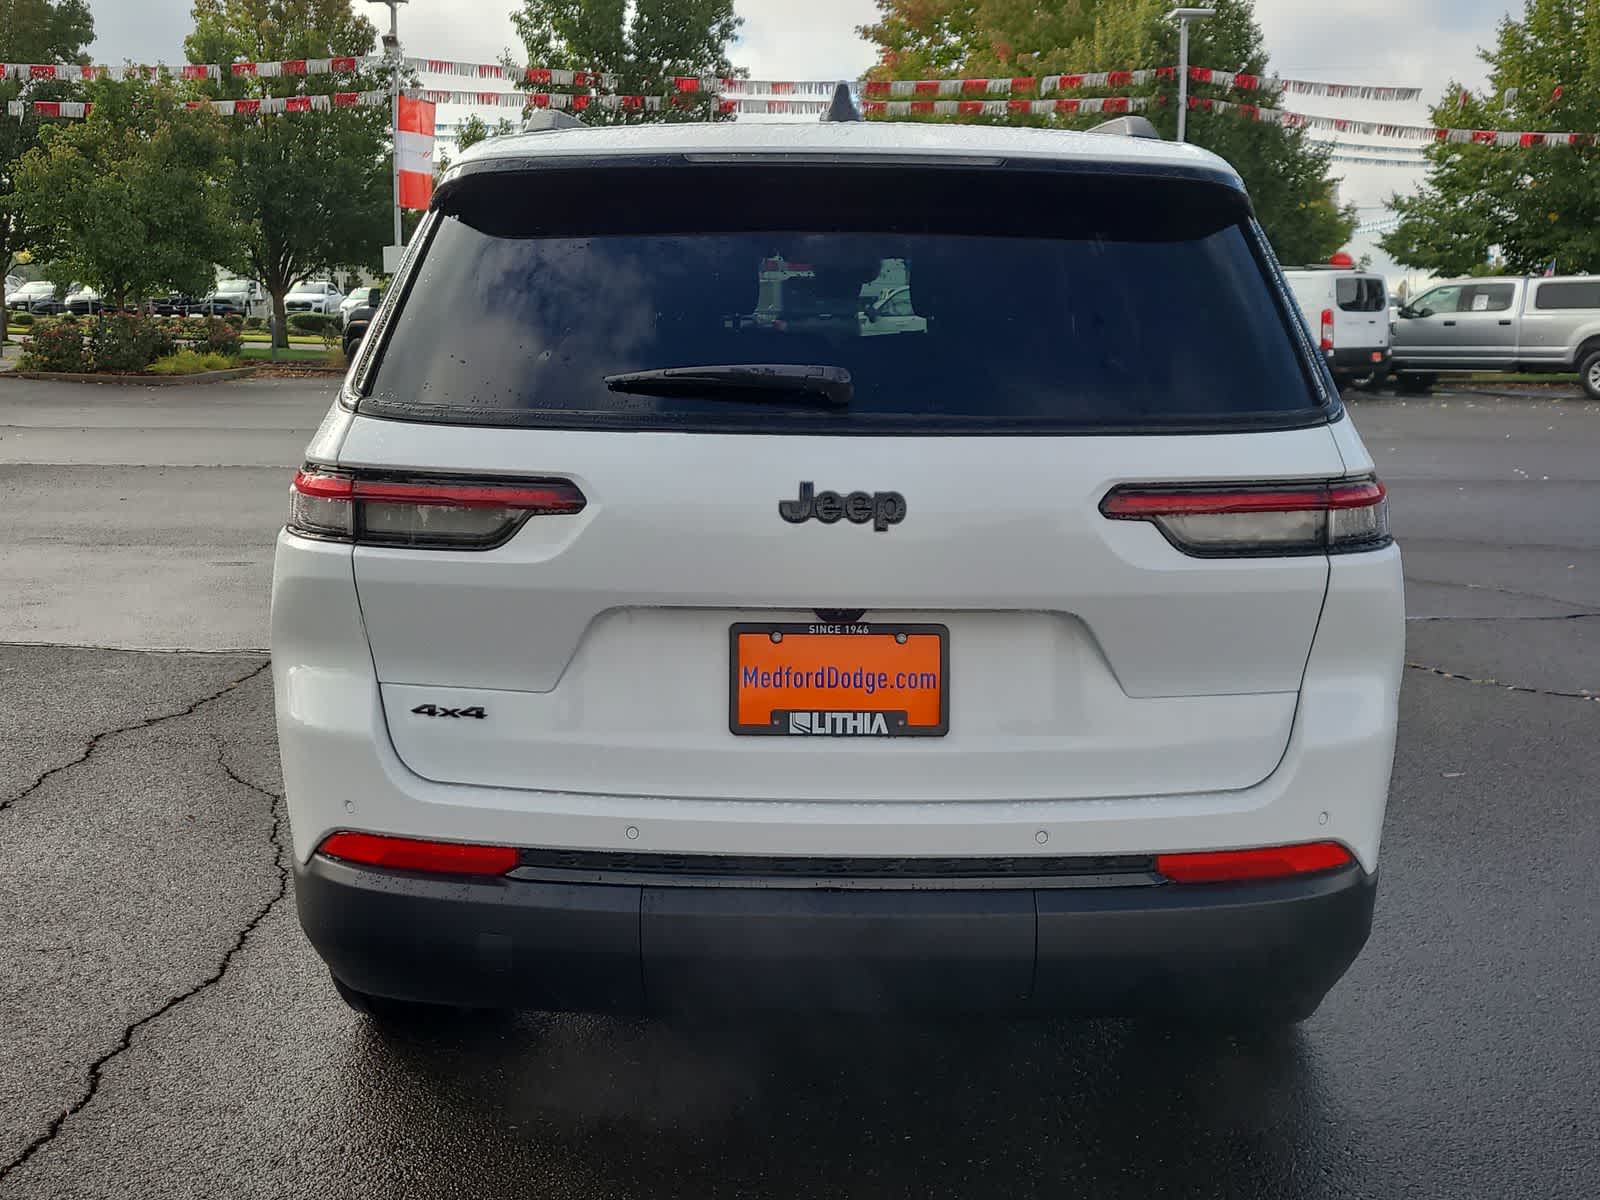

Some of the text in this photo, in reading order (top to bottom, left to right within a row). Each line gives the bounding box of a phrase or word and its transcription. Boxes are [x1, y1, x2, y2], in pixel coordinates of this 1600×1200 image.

[779, 481, 906, 532] Jeep
[809, 624, 869, 634] SINCE 1946
[742, 666, 937, 694] MedfordDodge.com
[411, 704, 488, 719] 4x4
[812, 712, 888, 734] LITHIA
